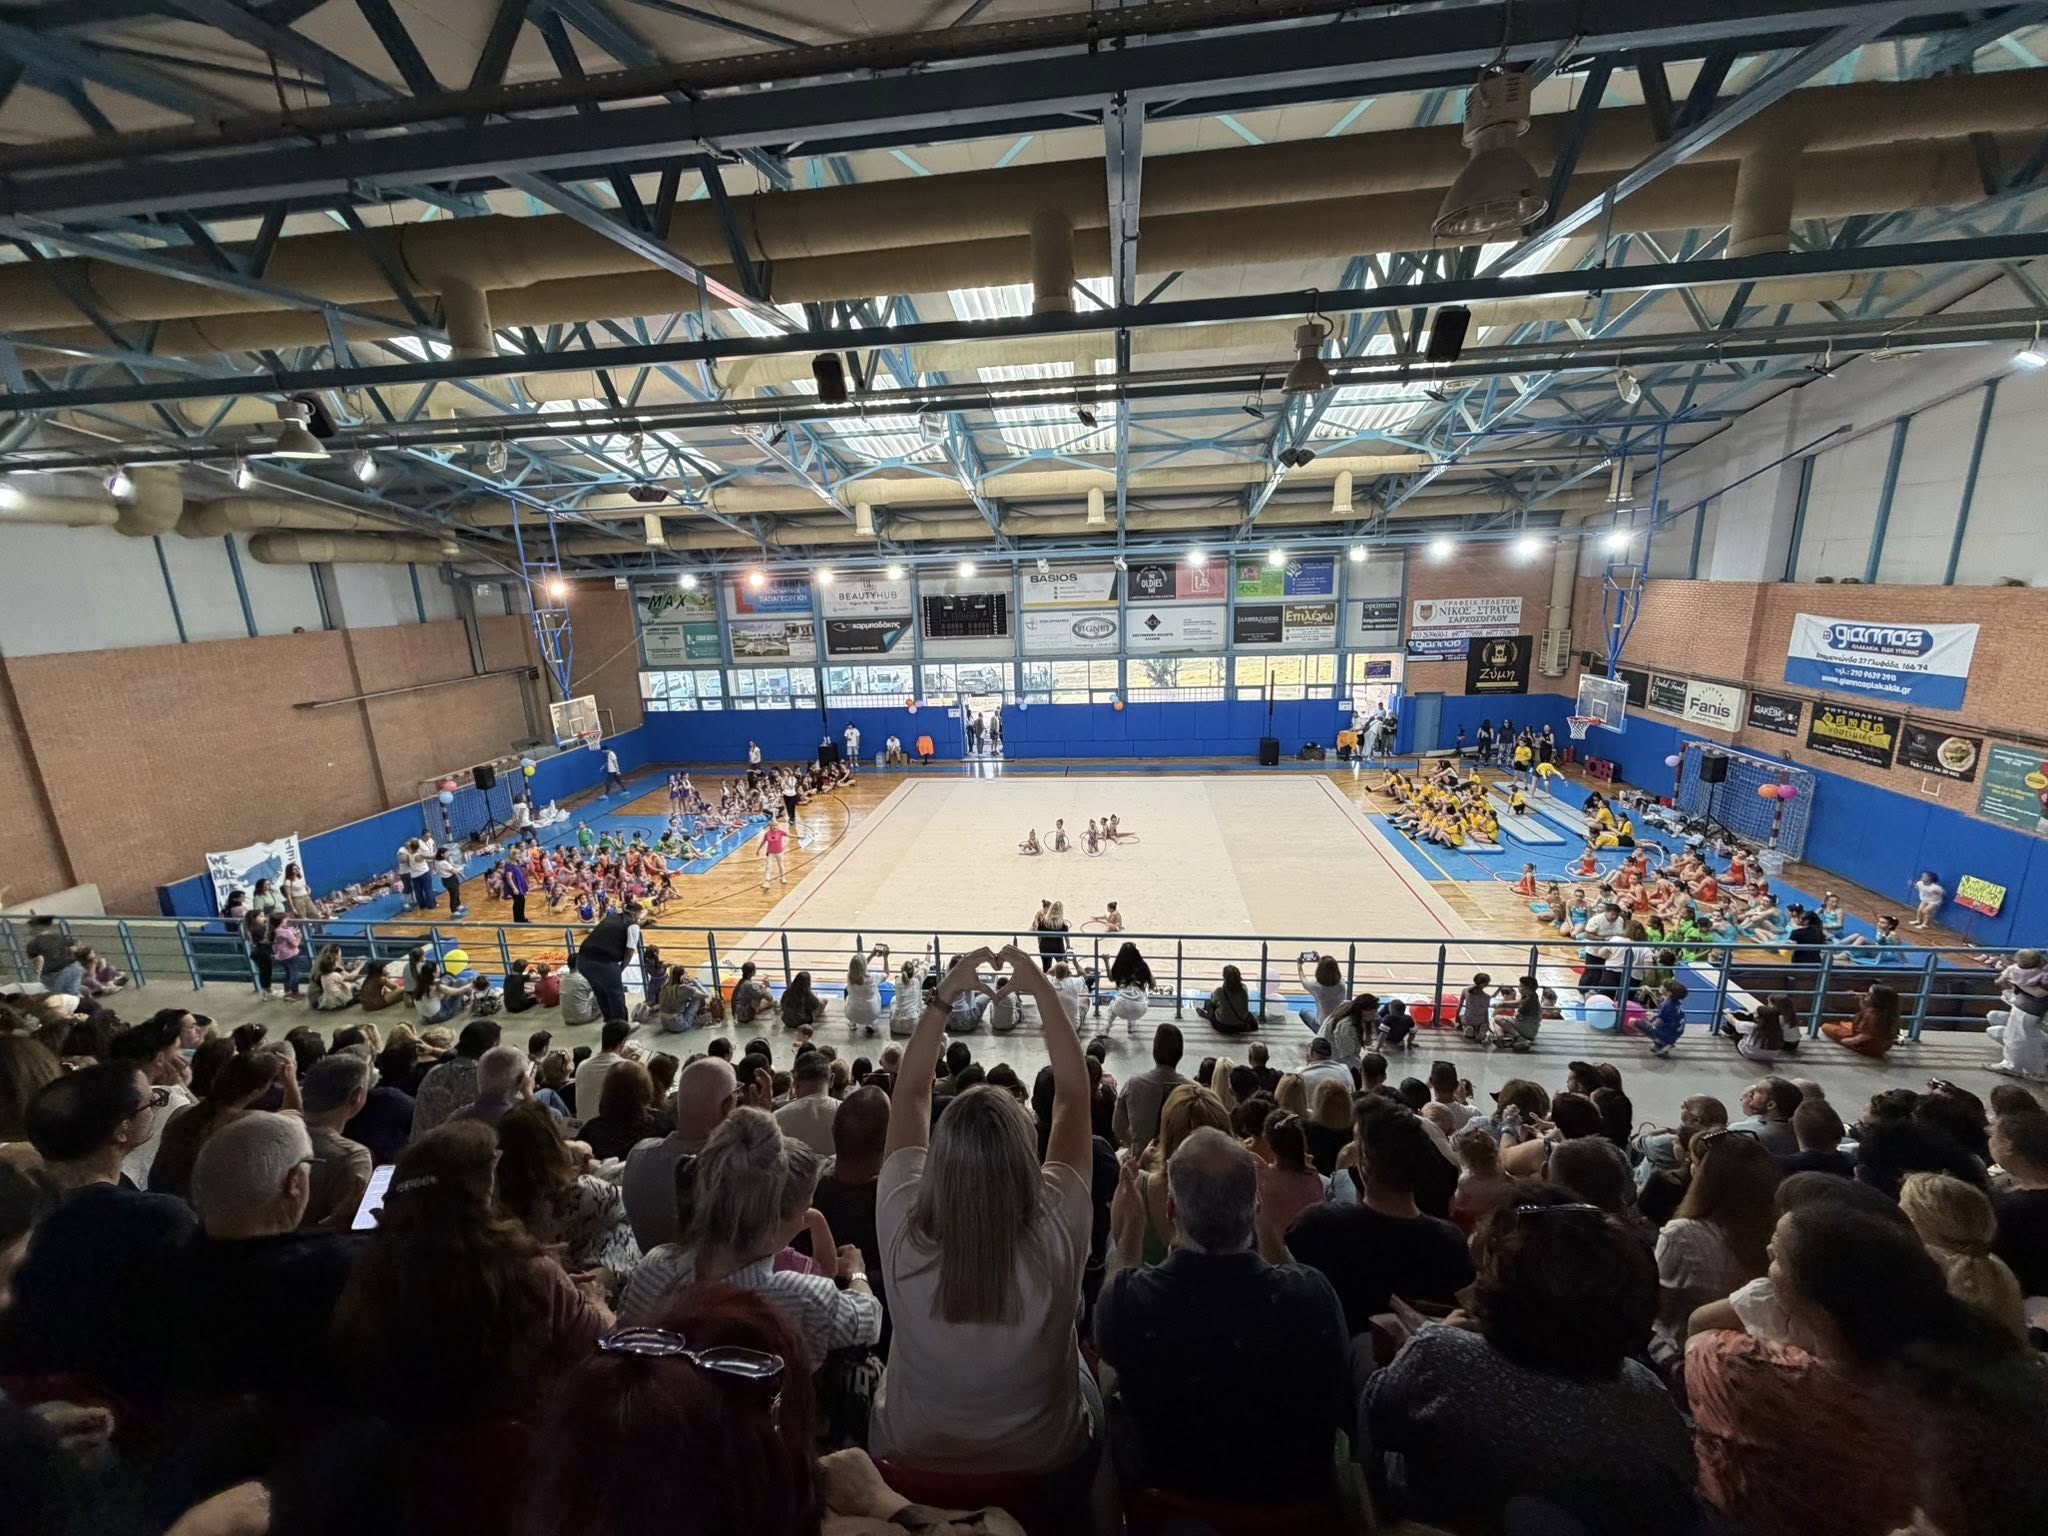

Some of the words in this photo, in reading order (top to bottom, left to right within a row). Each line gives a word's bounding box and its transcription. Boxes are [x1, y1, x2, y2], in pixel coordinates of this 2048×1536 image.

[1030, 573, 1078, 583] BASIOS
[1141, 579, 1163, 588] OLDIES
[648, 594, 688, 610] MAX
[838, 591, 898, 601] BEAUTYHUB
[1439, 606, 1472, 616] ΝΙΚΟΣ
[1477, 604, 1520, 615] ΣΤΡΑΤΟΣ
[1285, 610, 1334, 623] Επιλέγω
[1835, 625, 1923, 648] giannos
[1479, 667, 1516, 681] Ζύμη
[1850, 667, 1863, 676] 210
[1689, 697, 1730, 718] Fanis
[208, 854, 230, 865] WE
